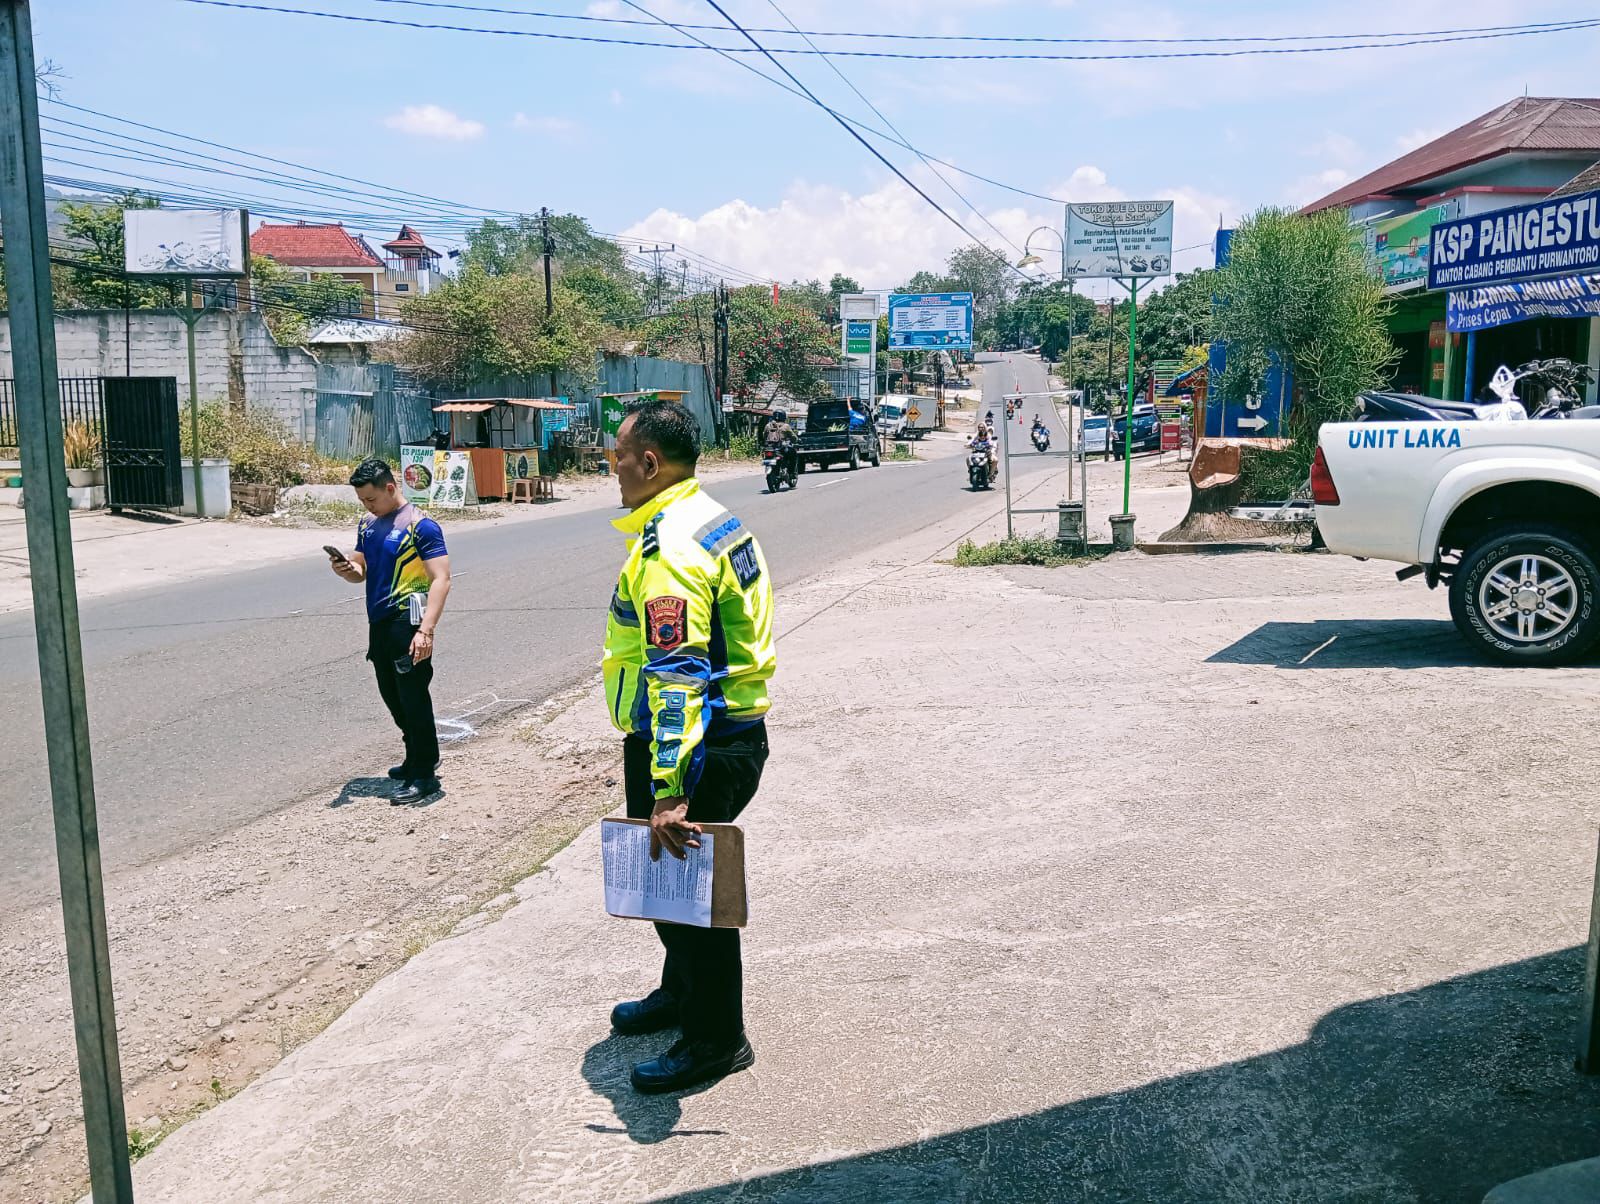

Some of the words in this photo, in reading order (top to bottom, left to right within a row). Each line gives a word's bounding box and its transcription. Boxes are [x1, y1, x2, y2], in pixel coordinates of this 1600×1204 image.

[1079, 205, 1104, 214] TOKO
[1128, 204, 1136, 212] &
[1138, 203, 1163, 212] BOLU
[1433, 223, 1474, 265] KSP
[1479, 197, 1600, 257] PANGESTU
[1436, 266, 1463, 285] KANTOR
[1464, 263, 1494, 281] CABANG
[1495, 256, 1537, 276] PEMBANTU
[1538, 245, 1599, 269] PURWANTORO
[1448, 284, 1520, 312] PINJAMAN
[1519, 276, 1586, 301] JAMINAN
[402, 448, 410, 456] ES
[411, 449, 434, 457] PISANG
[1348, 429, 1399, 449] UNIT
[1404, 428, 1461, 448] LAKA
